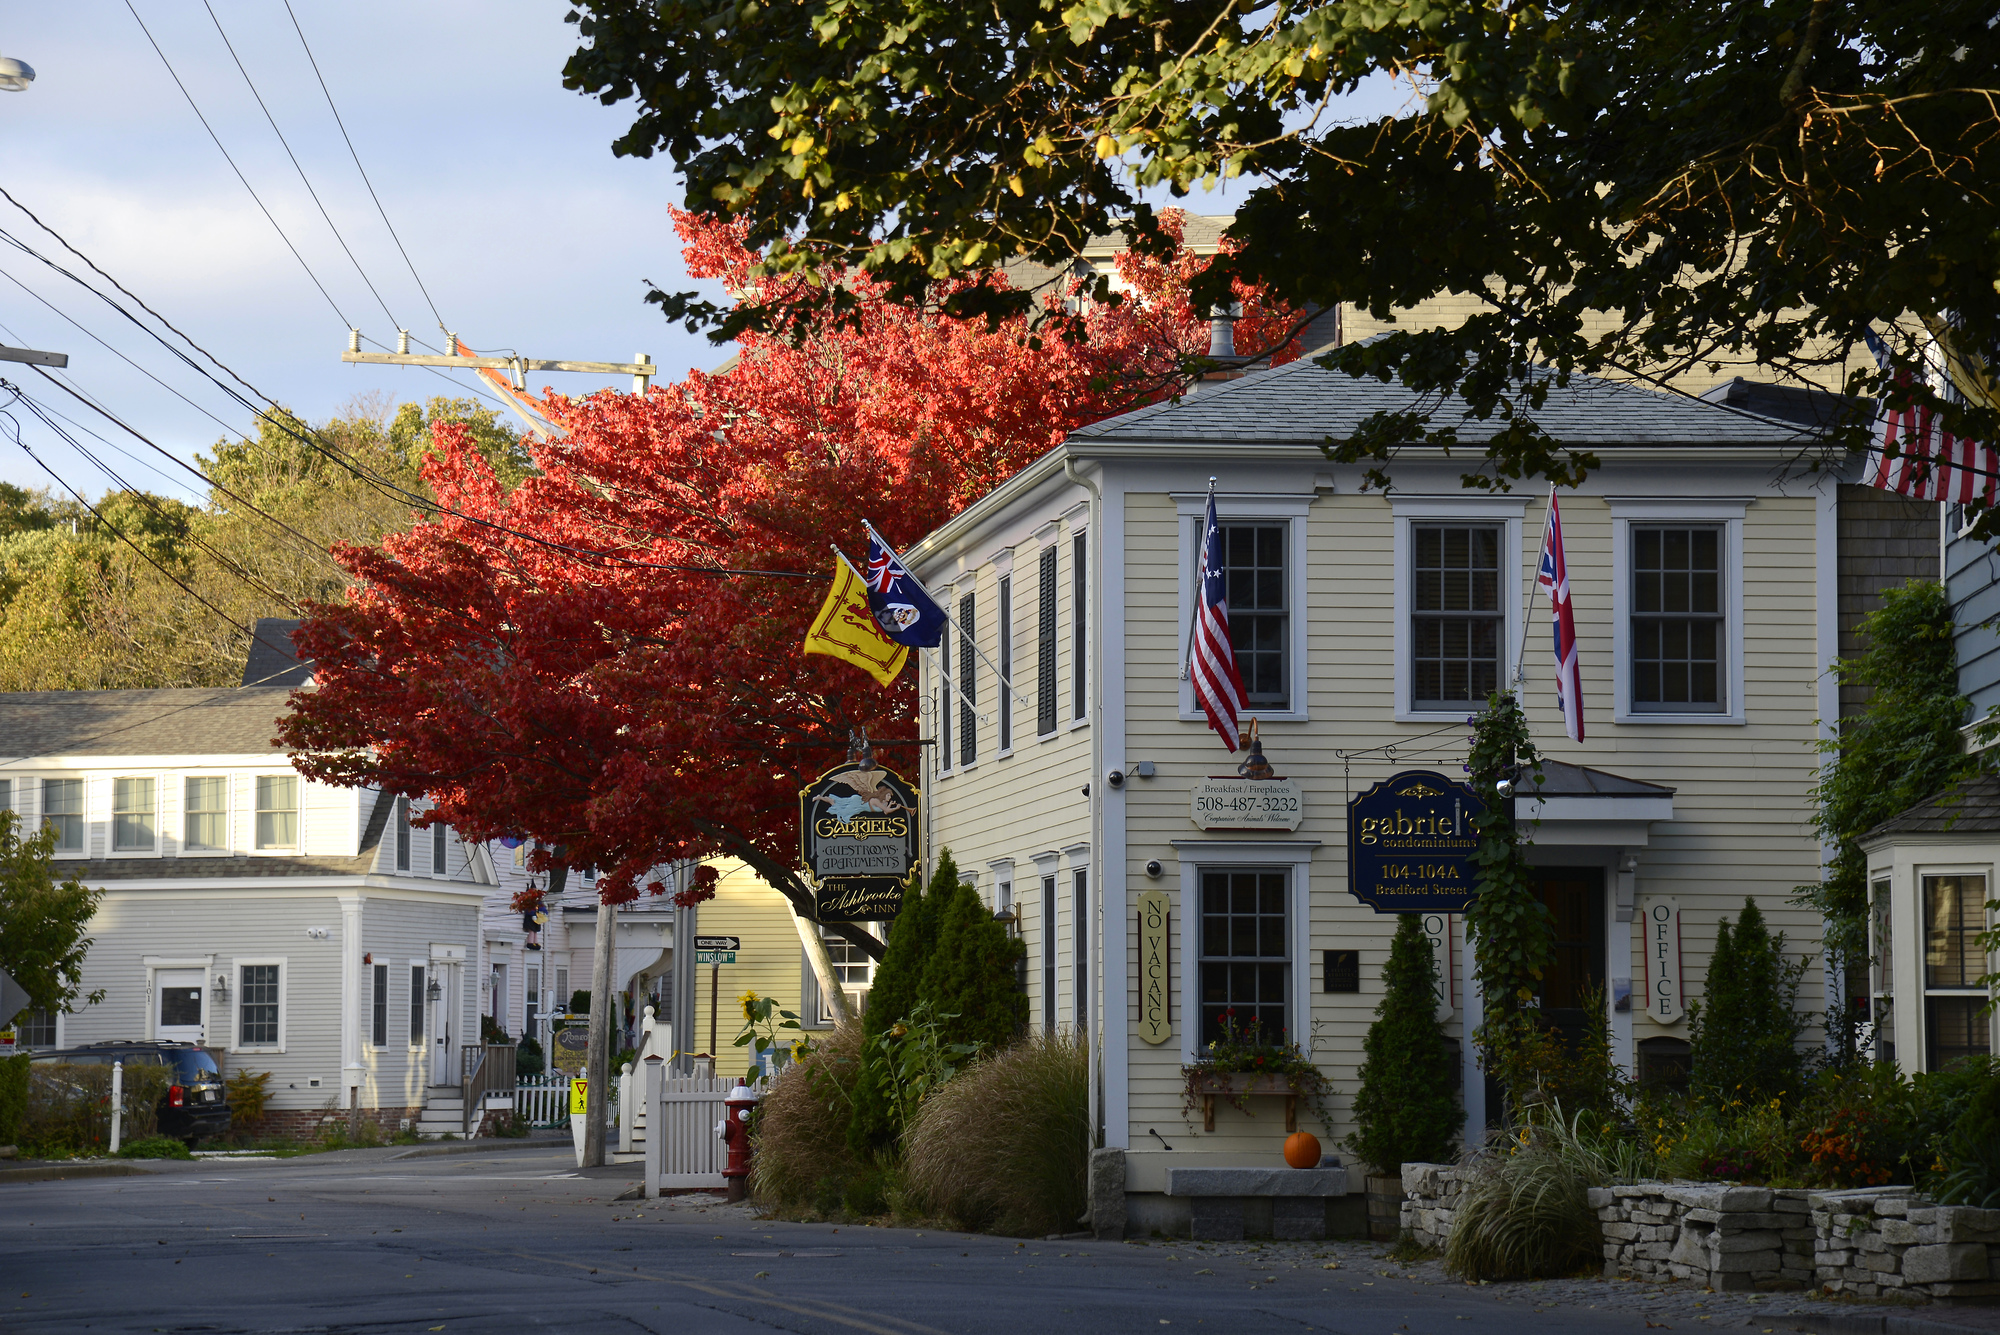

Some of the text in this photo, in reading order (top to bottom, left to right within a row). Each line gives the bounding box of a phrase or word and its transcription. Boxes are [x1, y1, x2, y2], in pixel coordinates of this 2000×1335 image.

[1204, 785, 1242, 793] Breakfast
[1249, 785, 1290, 795] Fireplaces
[1197, 797, 1298, 812] 508-487-3232
[1203, 812, 1291, 824] Companion Animals Welcome
[816, 817, 907, 838] GABRIEL'S
[1382, 836, 1477, 848] condominiums
[824, 844, 897, 857] GUESTROOMS
[822, 856, 900, 870] APARTMENTS
[1381, 864, 1461, 879] 104-104A
[827, 884, 847, 892] THE
[1375, 884, 1468, 895] Bradford Street
[820, 886, 902, 912] Ashbrooke
[873, 904, 897, 913] INN
[697, 953, 728, 962] WINSLOW
[1652, 905, 1672, 1015] OFFICE
[1147, 900, 1162, 1036] NO VACANCY
